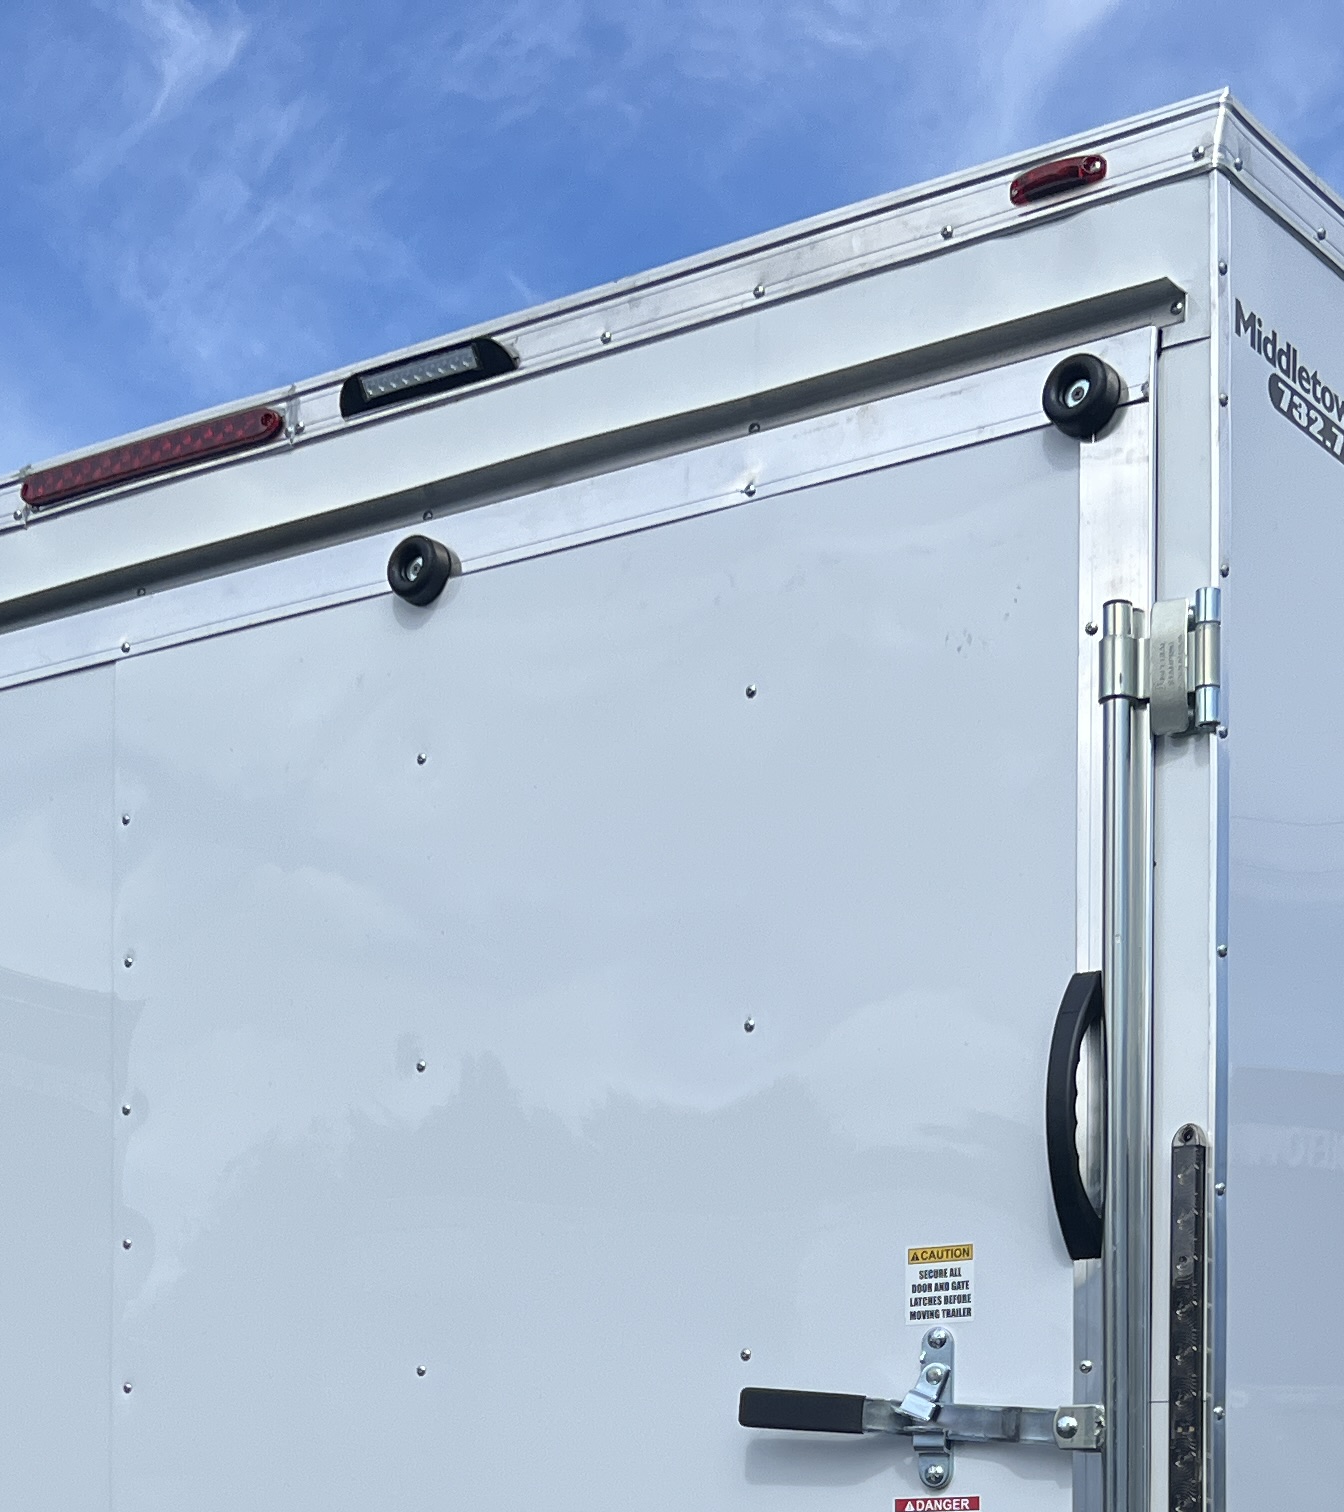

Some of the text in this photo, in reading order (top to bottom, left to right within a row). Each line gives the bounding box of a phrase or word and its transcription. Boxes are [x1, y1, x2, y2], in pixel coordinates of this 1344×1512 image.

[921, 1247, 970, 1261] CAUTION
[919, 1267, 962, 1280] SECURE ALL
[912, 1280, 970, 1294] DOOR AND GATE
[910, 1294, 972, 1307] LATCHES BEFORE
[910, 1307, 972, 1321] MOVING TRAILER
[916, 1498, 970, 1511] DANGER
